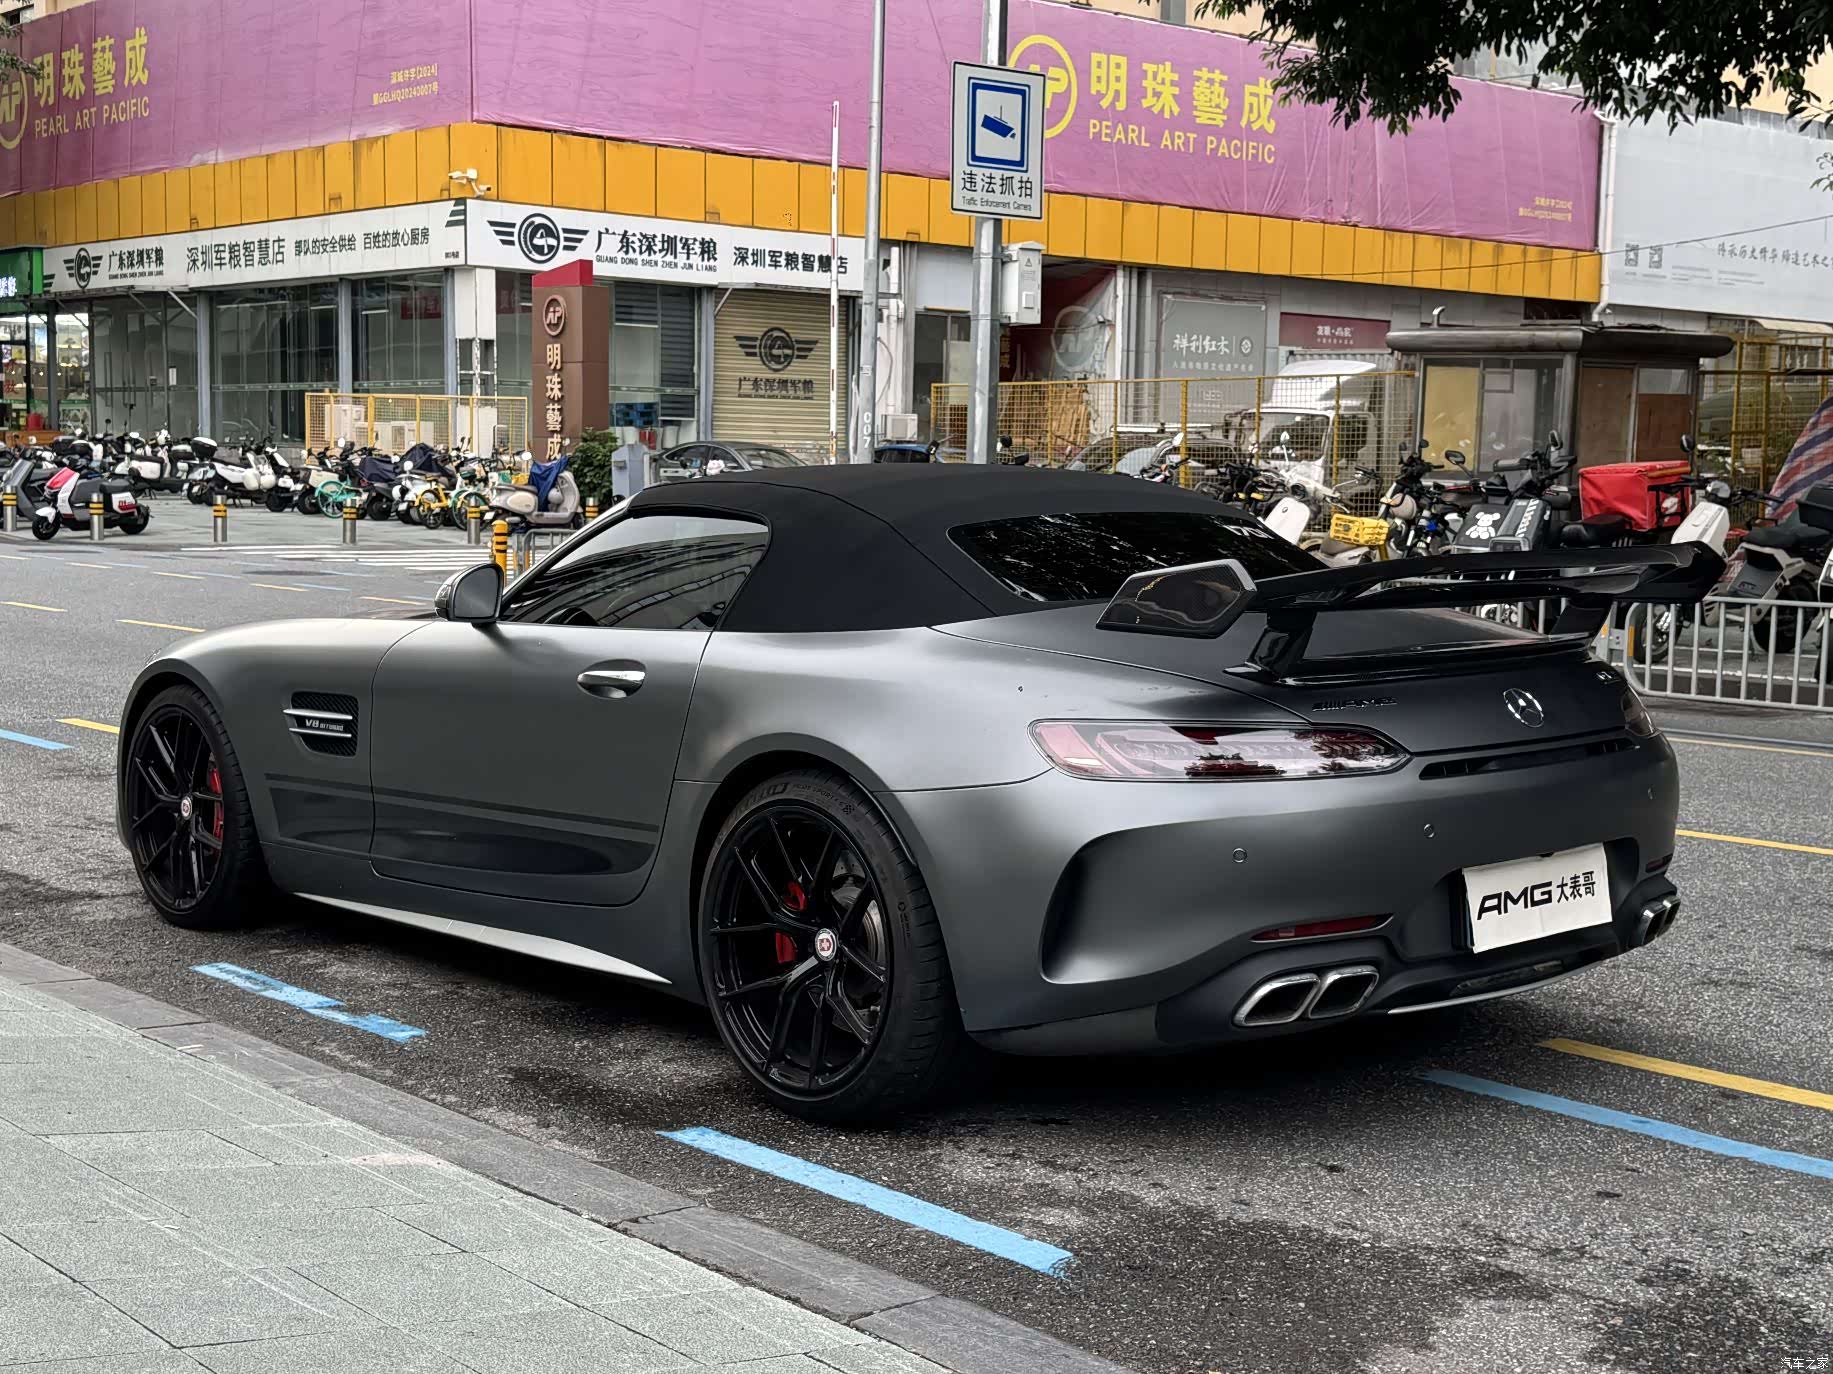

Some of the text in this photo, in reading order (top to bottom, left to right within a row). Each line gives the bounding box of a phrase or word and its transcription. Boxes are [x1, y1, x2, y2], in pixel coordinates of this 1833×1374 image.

[33, 26, 149, 108] 明珠藝成
[1090, 52, 1276, 134] 明珠藝成
[35, 96, 149, 138] PEARL ART PACIFIC
[1089, 119, 1276, 163] PEARL ART PACIFIC
[961, 170, 1033, 199] 违法抓拍
[108, 246, 164, 272] 广东深圳军粮
[186, 236, 286, 274] 深圳军粮智慧店
[294, 227, 430, 257] 部队的安全供给 百姓的放心厨房
[595, 227, 718, 262] 广东深圳军粮
[733, 246, 848, 274] 深圳军粮智慧店
[595, 254, 717, 272] GUANG DONG SHEN ZHEN JUN LIANG
[546, 343, 562, 460] 明珠藝成
[863, 412, 872, 449] 007
[305, 719, 320, 728] V8
[1477, 871, 1597, 921] AMG 大表哥
